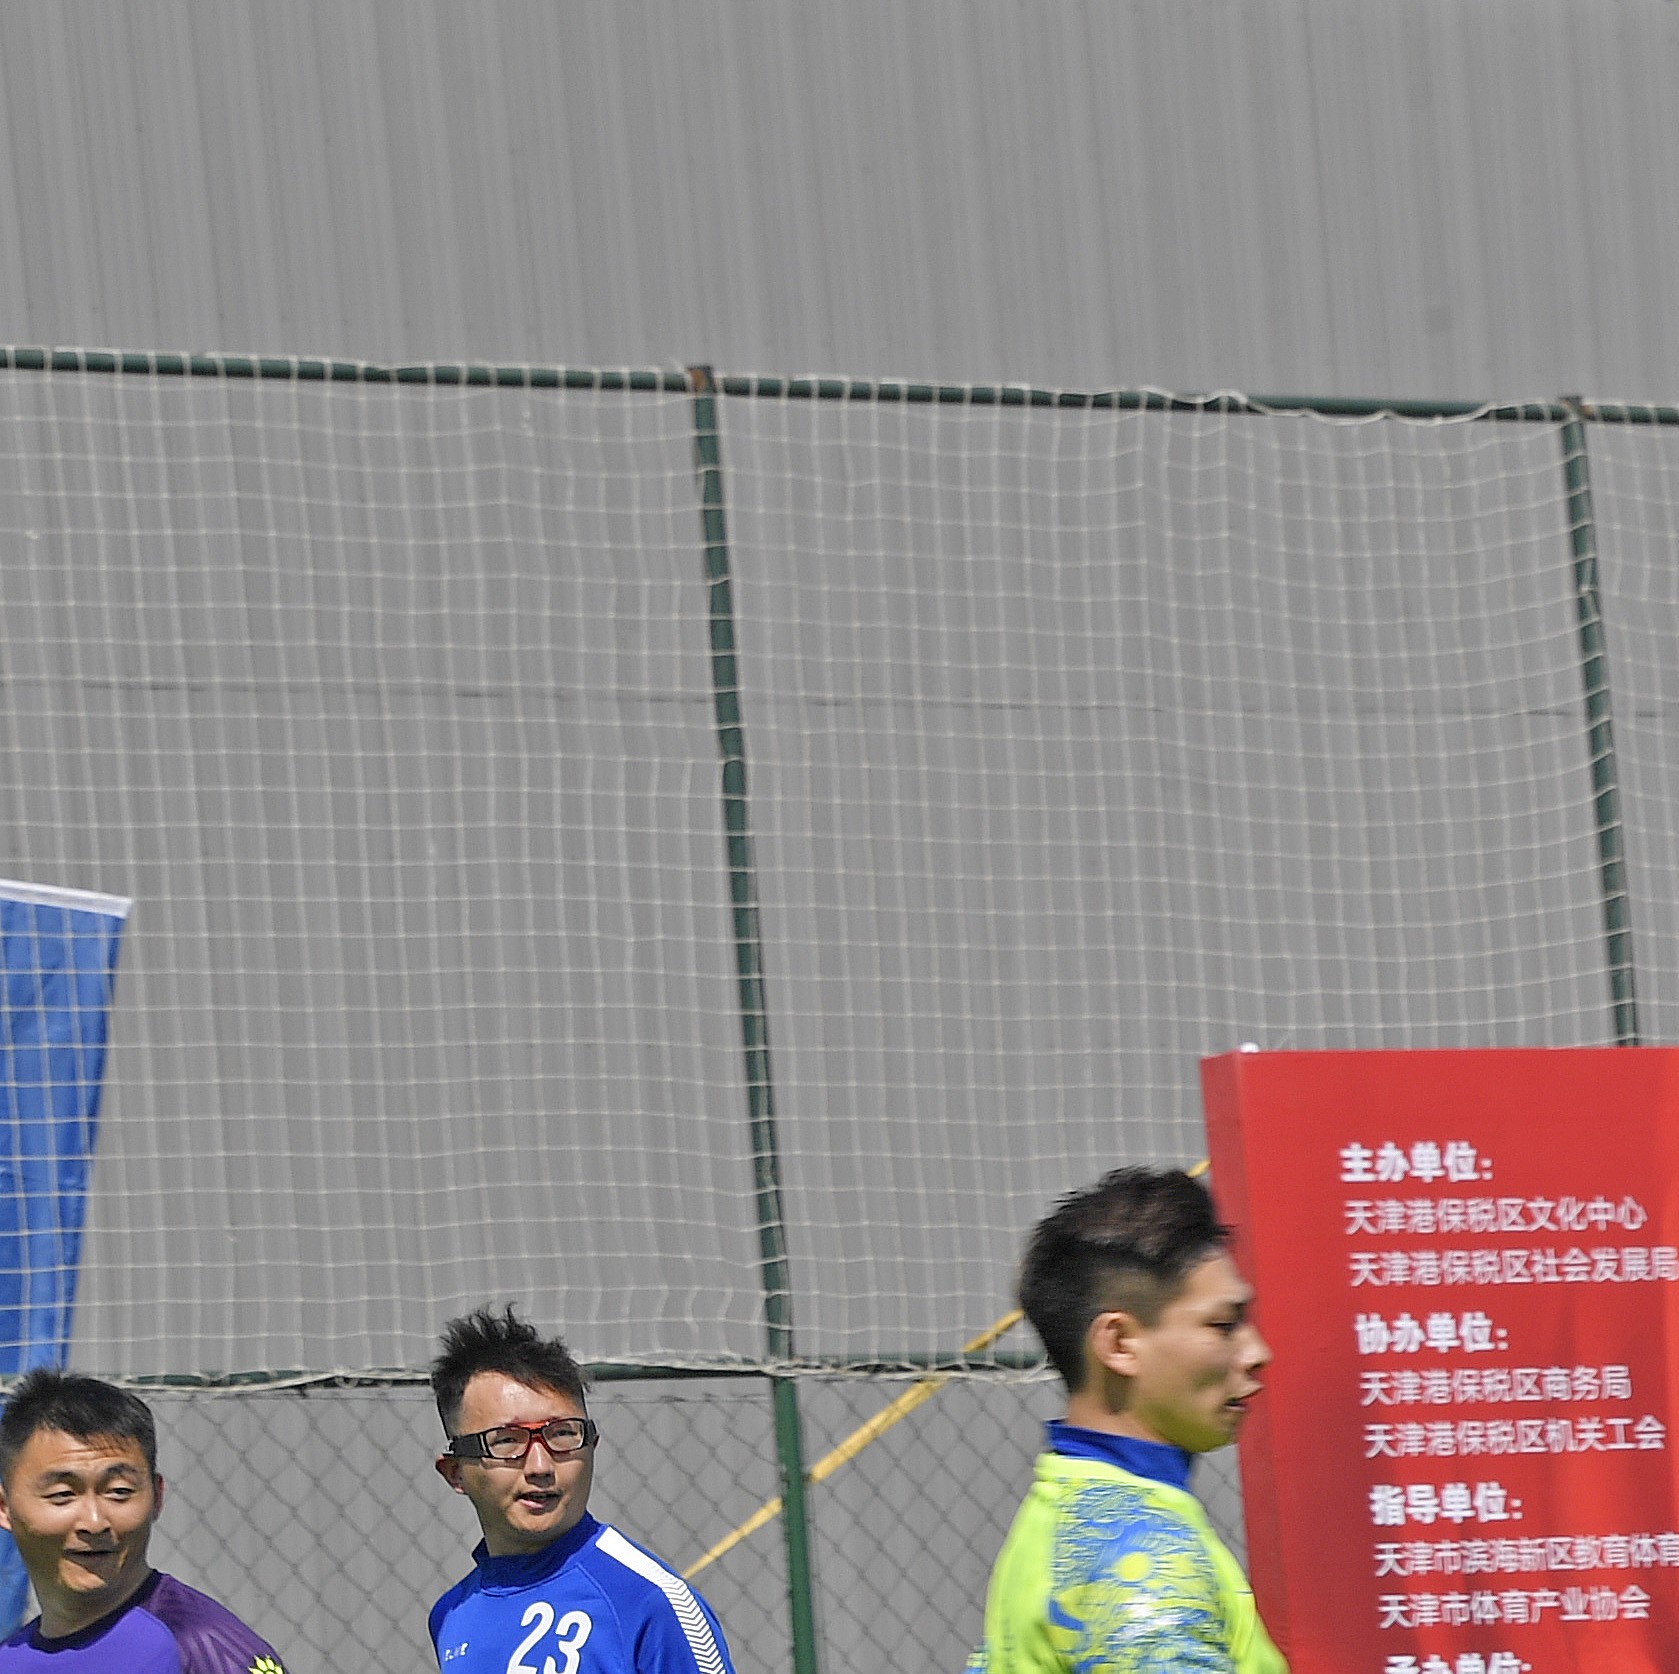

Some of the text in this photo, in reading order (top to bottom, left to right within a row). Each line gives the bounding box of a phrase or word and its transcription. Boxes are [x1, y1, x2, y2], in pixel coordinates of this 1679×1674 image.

[1340, 1141, 1494, 1182] 主办单位：
[1344, 1197, 1648, 1235] 天津港保税区文化中心
[1354, 1313, 1510, 1354] 协办单位：
[1360, 1364, 1632, 1408] 天津港保税区商务局
[1364, 1416, 1666, 1460] 天津港保税区机关工会
[1369, 1482, 1523, 1525] 指导单位：
[1379, 1584, 1651, 1629] 天津市体育产业协会
